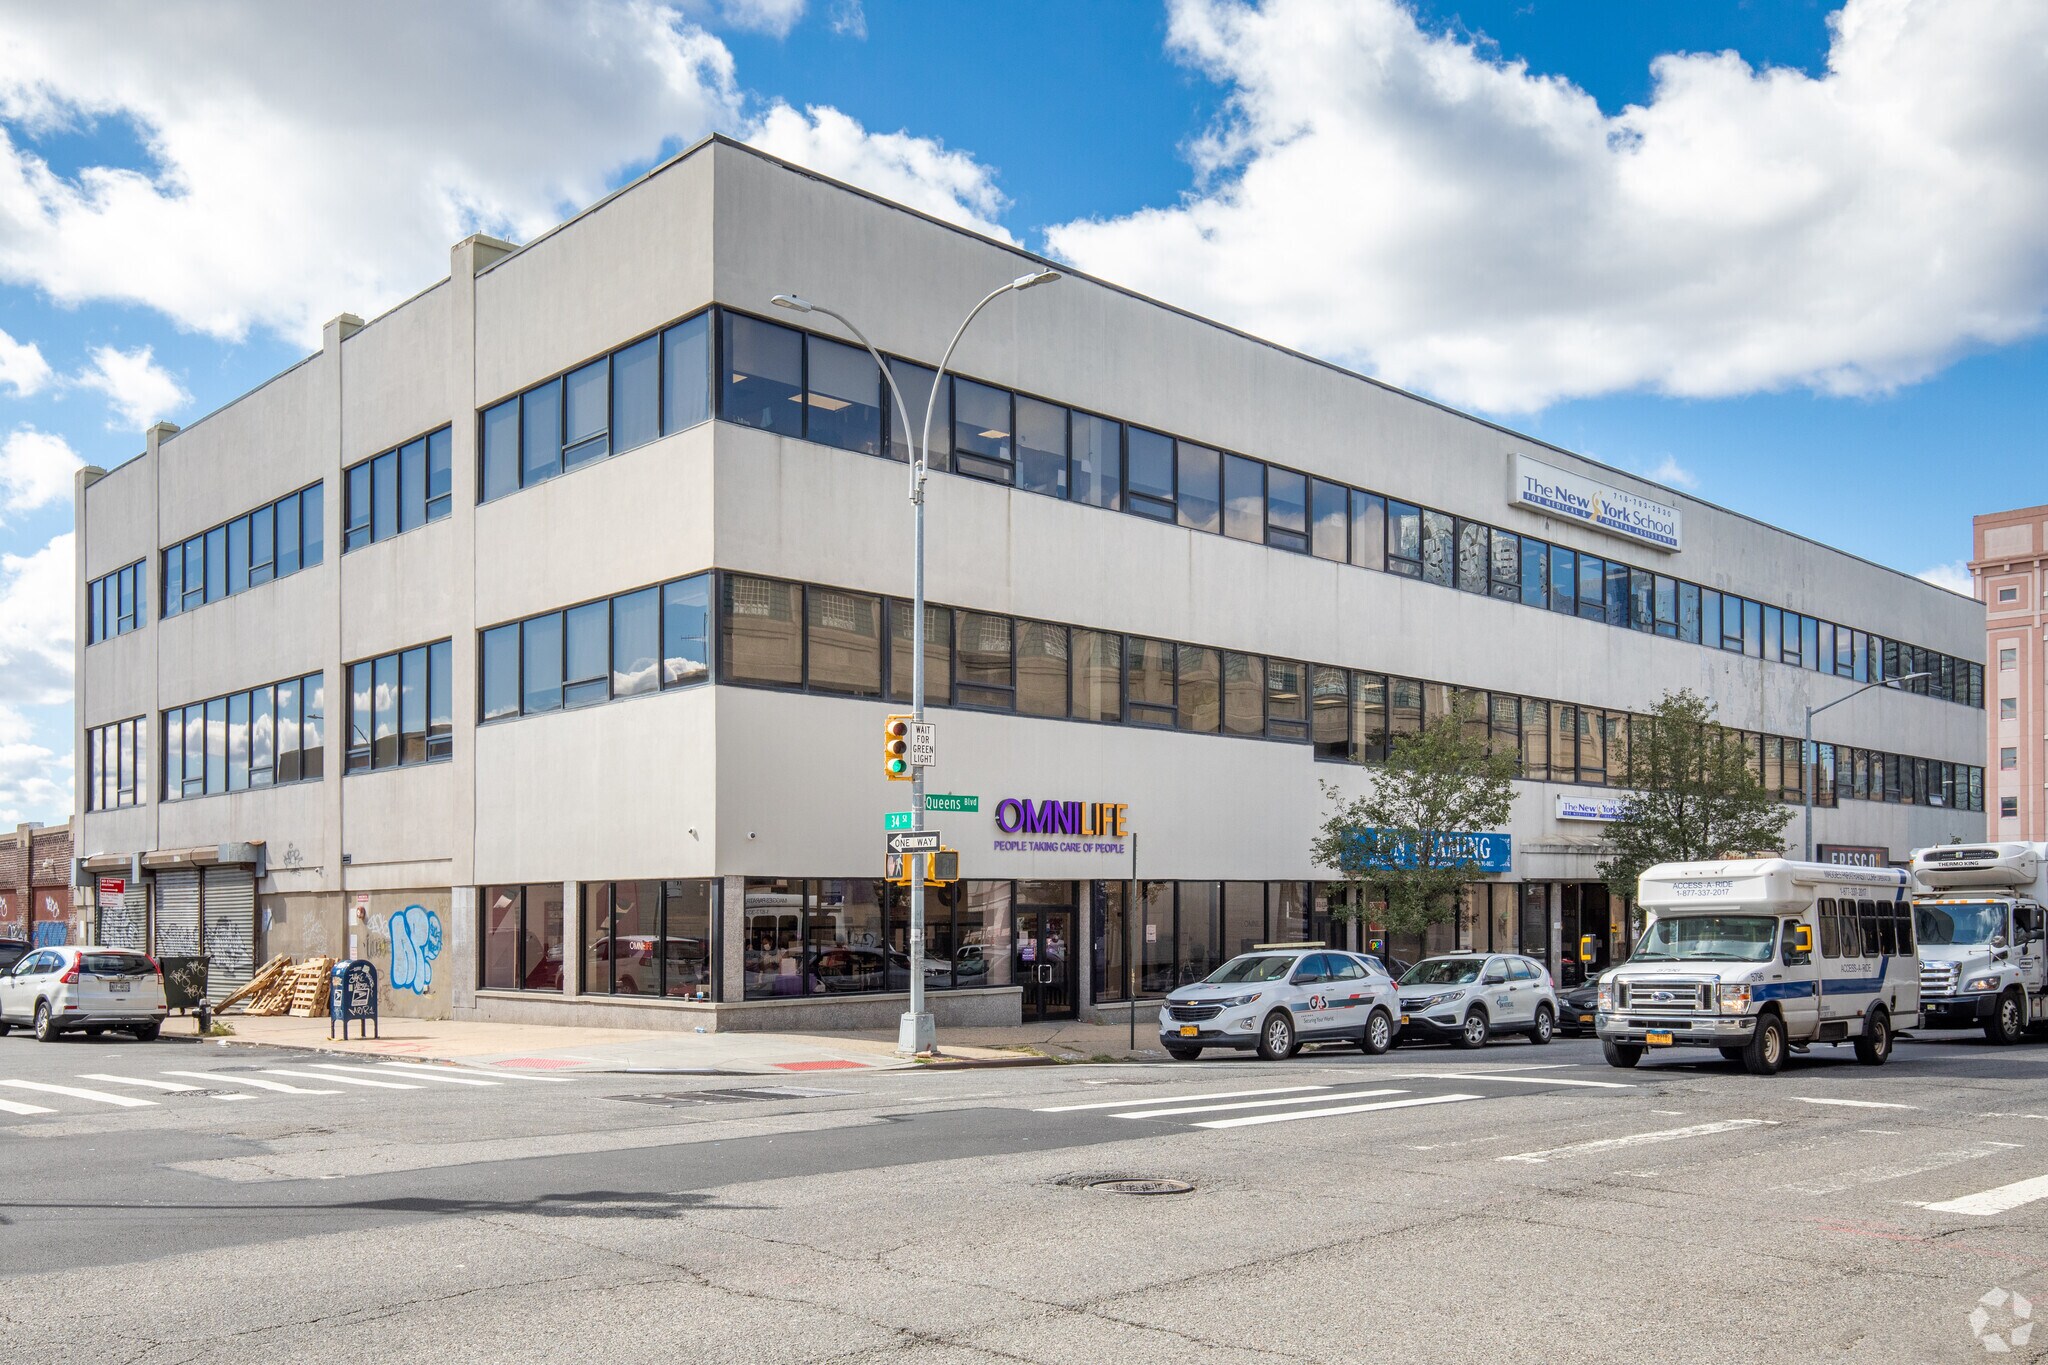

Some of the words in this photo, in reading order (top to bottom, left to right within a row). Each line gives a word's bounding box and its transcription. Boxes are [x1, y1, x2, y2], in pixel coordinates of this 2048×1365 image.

[1524, 475, 1553, 498] The
[1555, 485, 1590, 509] New
[1601, 499, 1631, 523] York
[1633, 510, 1674, 536] School
[1526, 493, 1542, 503] FOR
[1545, 500, 1579, 515] MEDICAL
[1605, 518, 1632, 532] DENTAL
[1635, 528, 1675, 545] ASSISTANTS
[916, 725, 930, 734] WAIT
[916, 735, 930, 744] FOR
[912, 744, 934, 754] GREEN
[913, 754, 932, 764] LIGHT
[926, 796, 961, 810] Queens
[964, 798, 977, 806] Blvd
[1563, 802, 1578, 811] The
[1578, 803, 1596, 812] New
[1602, 804, 1617, 813] York
[891, 815, 900, 828] 34
[995, 798, 1129, 837] OMNILIFE
[895, 838, 910, 848] ONE
[916, 837, 934, 846] WAY
[993, 840, 1027, 852] PEOPLE
[1028, 841, 1059, 852] TAKING
[1059, 842, 1081, 853] CARE
[1082, 843, 1094, 853] OF
[1095, 843, 1125, 854] PEOPLE
[1676, 888, 1730, 897] 1-877-337-2017
[1750, 972, 1765, 982] 5796
